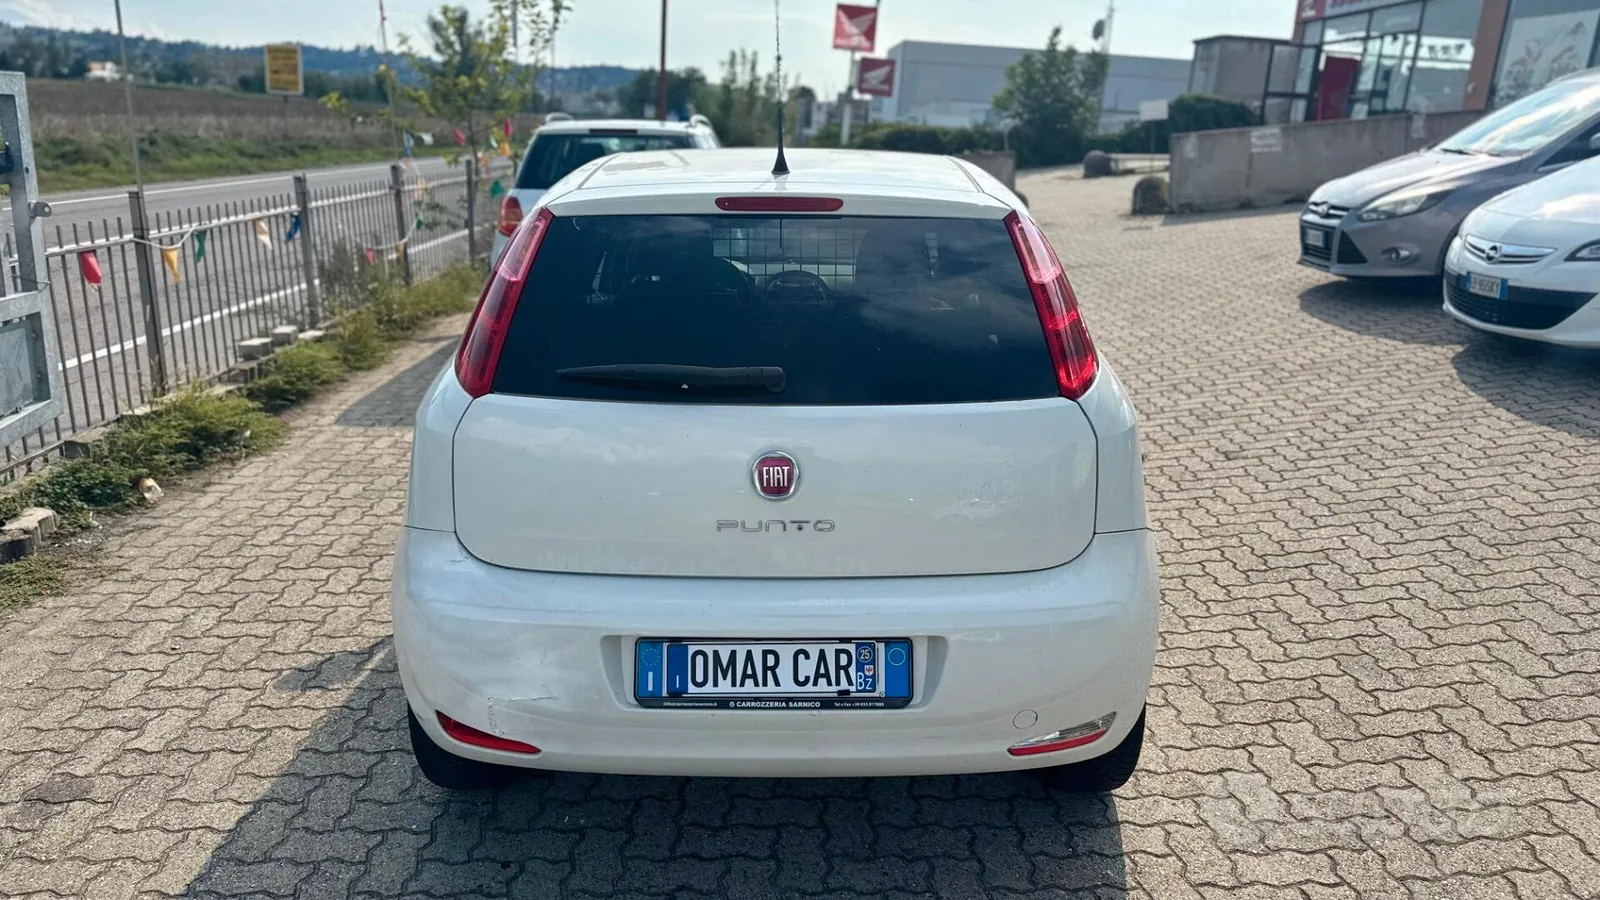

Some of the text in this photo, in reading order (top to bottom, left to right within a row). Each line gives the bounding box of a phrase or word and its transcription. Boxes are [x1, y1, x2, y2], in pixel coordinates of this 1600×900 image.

[762, 466, 790, 488] FIAT
[716, 519, 836, 533] PUNTO
[859, 649, 870, 660] 25
[690, 647, 855, 688] OMAR CAR
